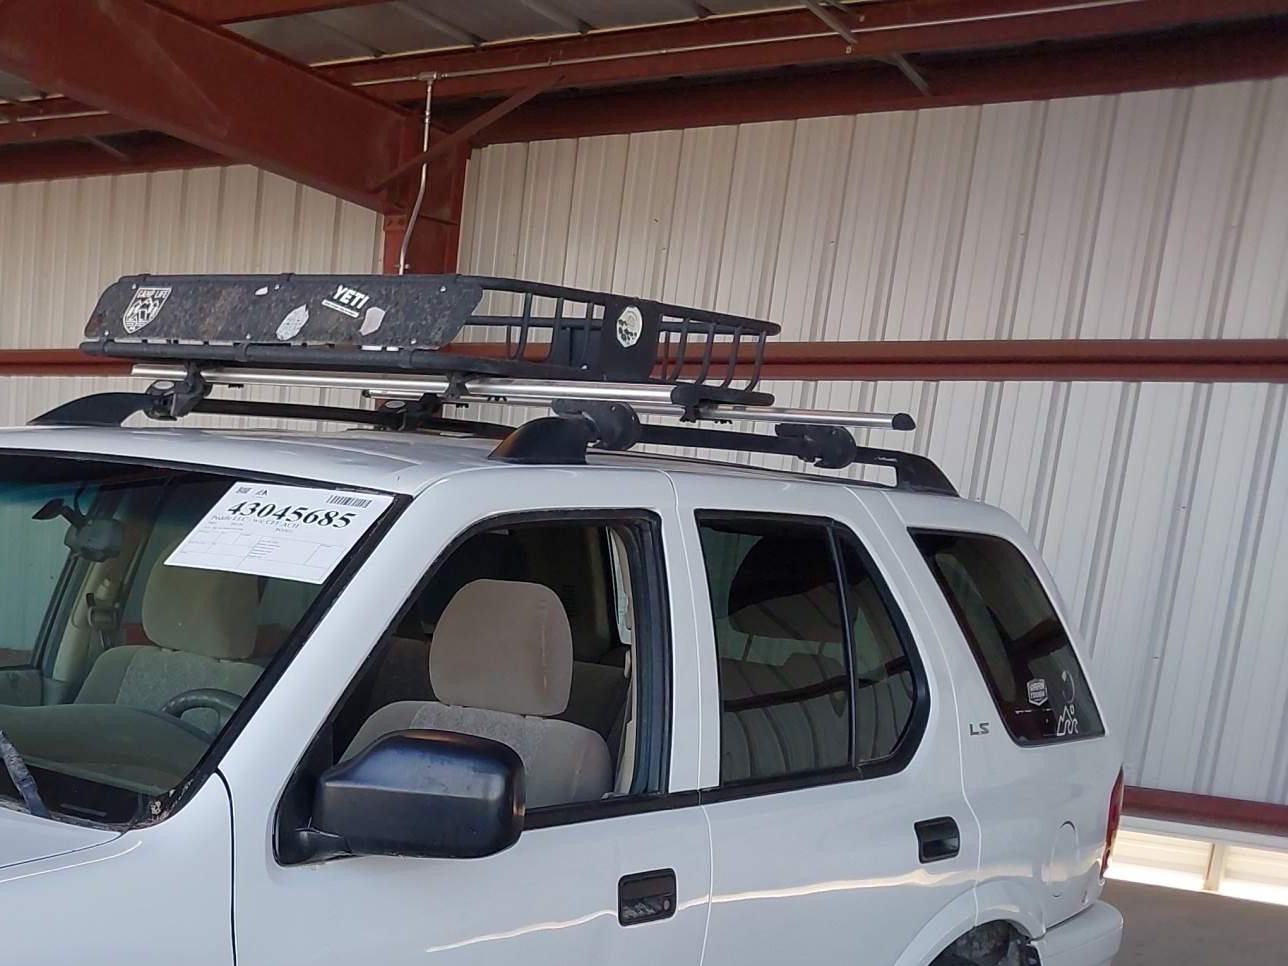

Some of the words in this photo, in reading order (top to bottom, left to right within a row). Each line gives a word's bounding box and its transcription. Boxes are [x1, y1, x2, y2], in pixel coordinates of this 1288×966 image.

[332, 284, 370, 310] YETI
[227, 500, 359, 530] 43045685
[969, 722, 990, 736] LS
